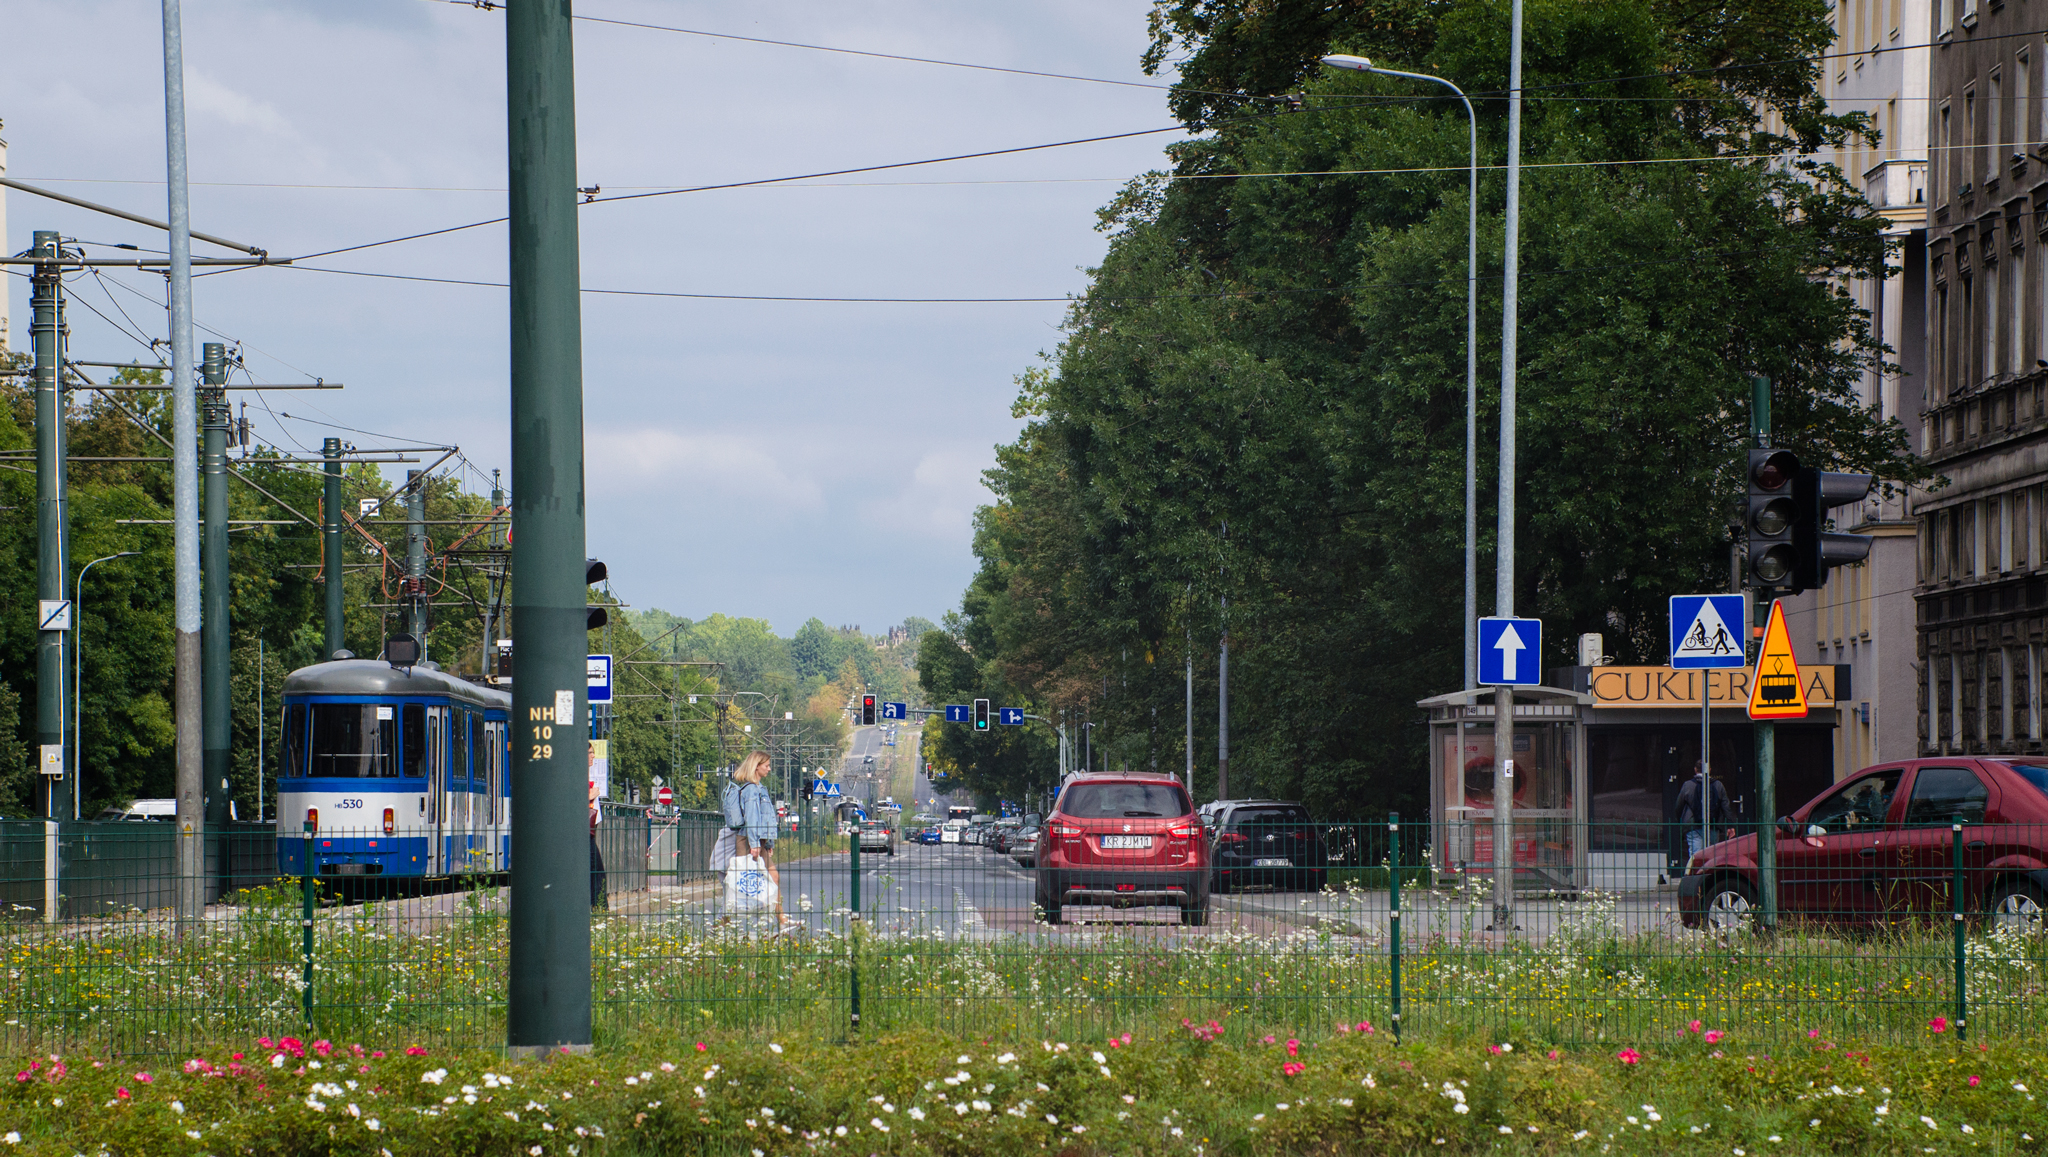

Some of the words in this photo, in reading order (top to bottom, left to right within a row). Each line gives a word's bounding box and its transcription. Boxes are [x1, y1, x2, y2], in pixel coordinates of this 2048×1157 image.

[1593, 671, 1833, 701] CUKIERA
[530, 706, 554, 721] NH
[532, 725, 553, 740] 10
[532, 744, 553, 759] 29
[1106, 836, 1119, 846] KR
[1122, 836, 1149, 846] 2JM11
